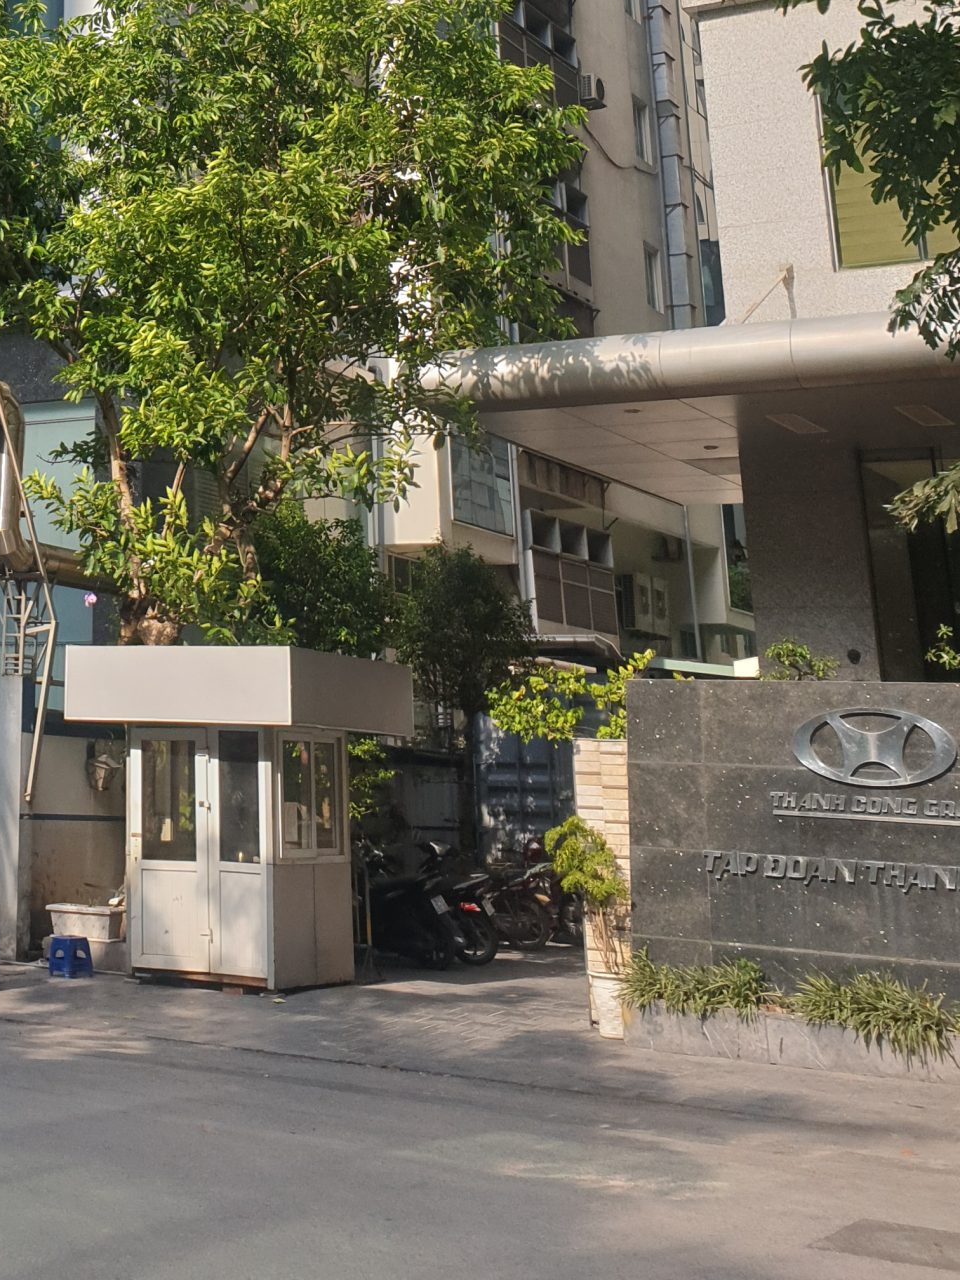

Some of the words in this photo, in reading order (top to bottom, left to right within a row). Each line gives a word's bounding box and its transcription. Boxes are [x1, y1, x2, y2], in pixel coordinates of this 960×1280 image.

[769, 791, 846, 812] THANH
[923, 799, 960, 818] GR
[865, 862, 960, 895] THAN
